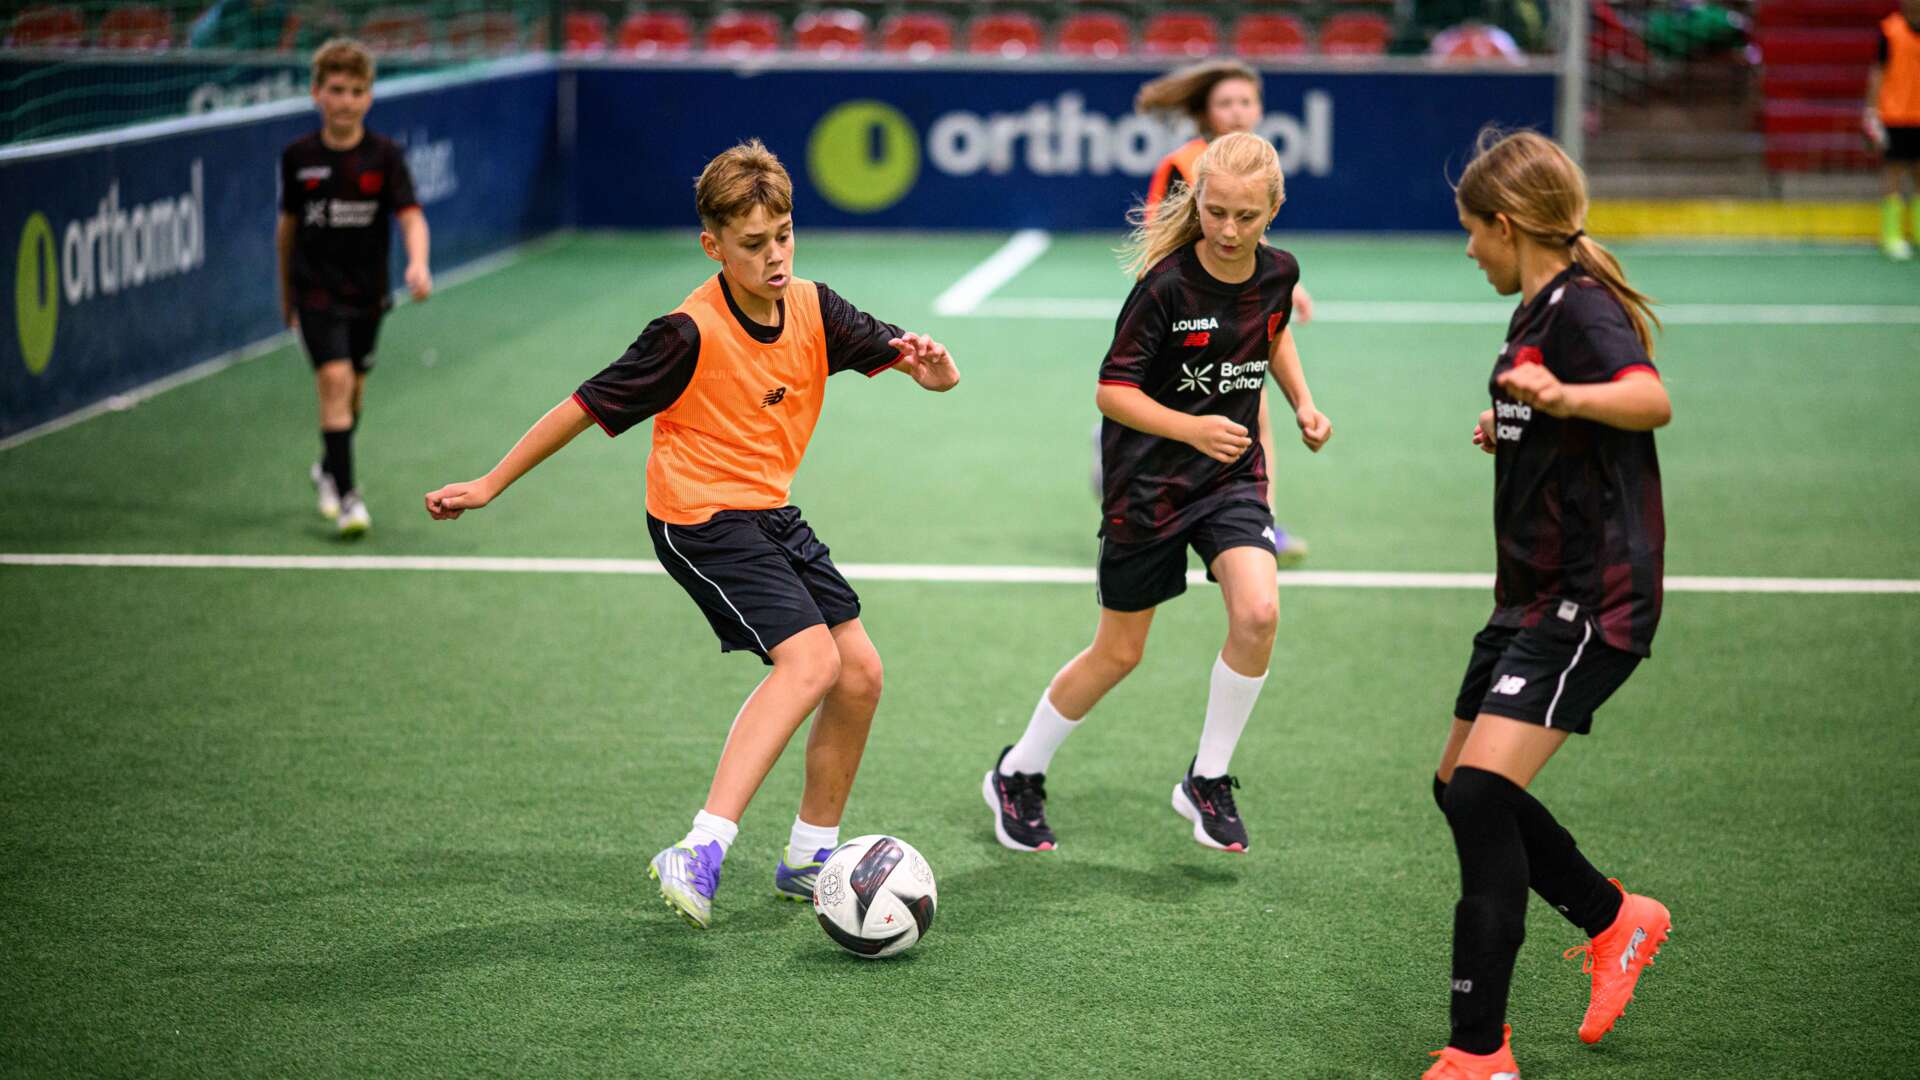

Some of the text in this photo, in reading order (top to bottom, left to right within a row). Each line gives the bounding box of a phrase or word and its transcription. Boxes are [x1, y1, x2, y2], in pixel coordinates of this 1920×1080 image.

[63, 157, 204, 304] orthomol
[1172, 317, 1219, 332] LOUISA
[1491, 674, 1527, 695] NB
